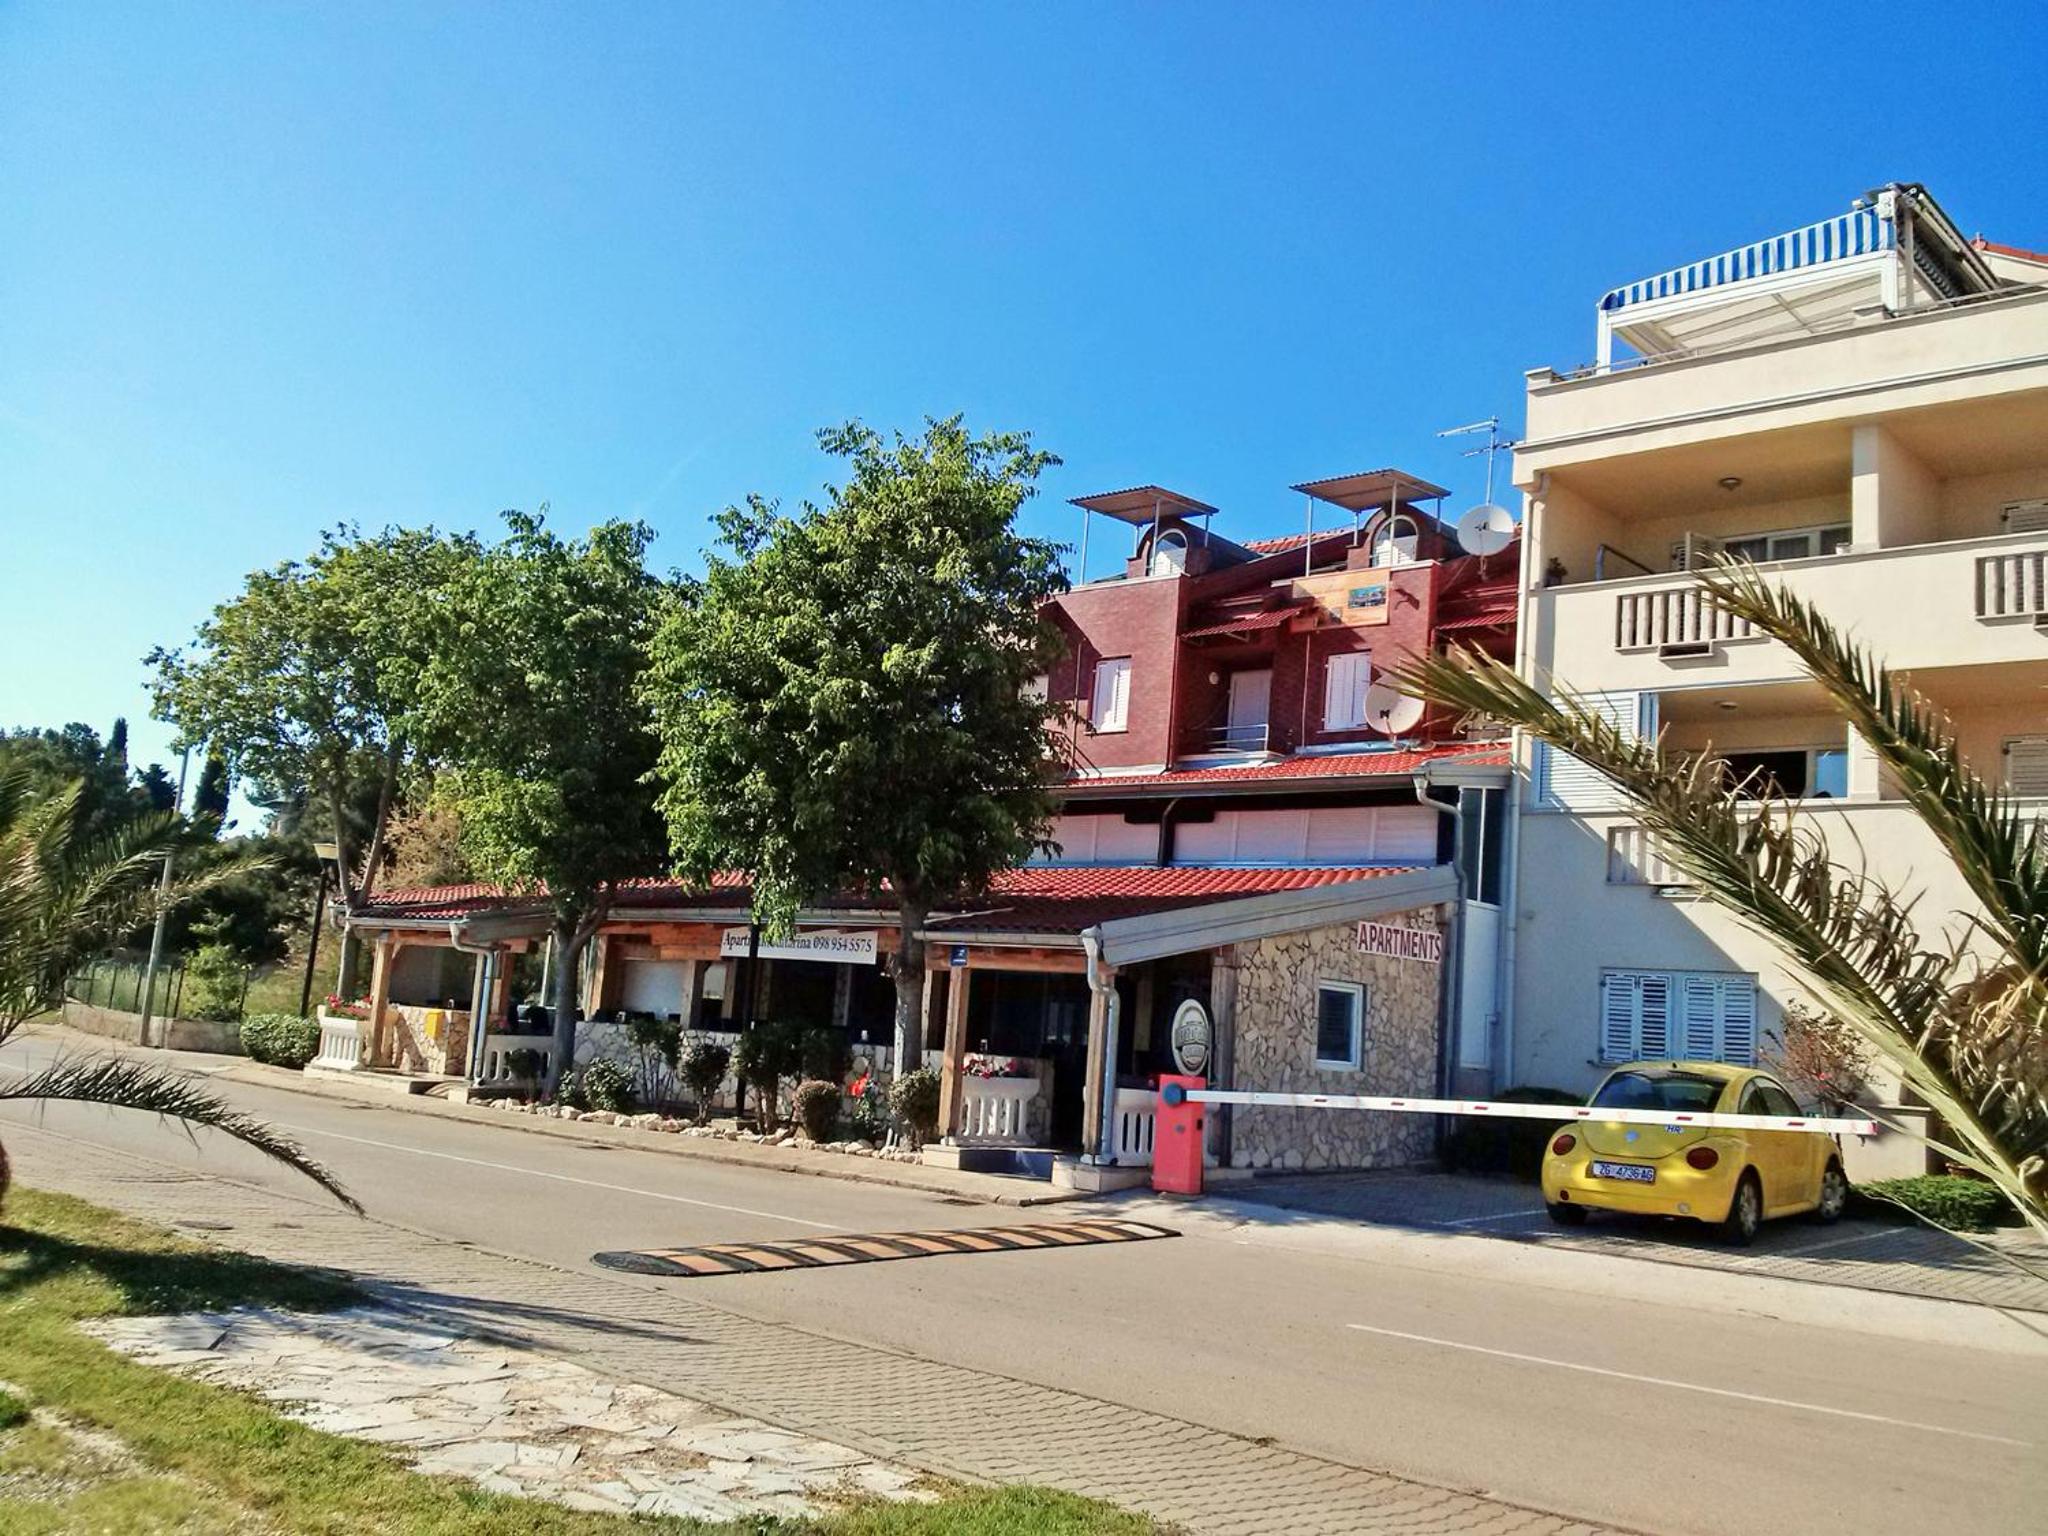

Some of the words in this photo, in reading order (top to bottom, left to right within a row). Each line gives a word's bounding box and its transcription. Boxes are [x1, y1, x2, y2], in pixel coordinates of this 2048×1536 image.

[813, 935, 830, 950] 098
[831, 937, 848, 951] 954
[849, 938, 872, 953] 5575
[1358, 923, 1441, 961] APARTMENTS
[1599, 1163, 1611, 1176] ZG
